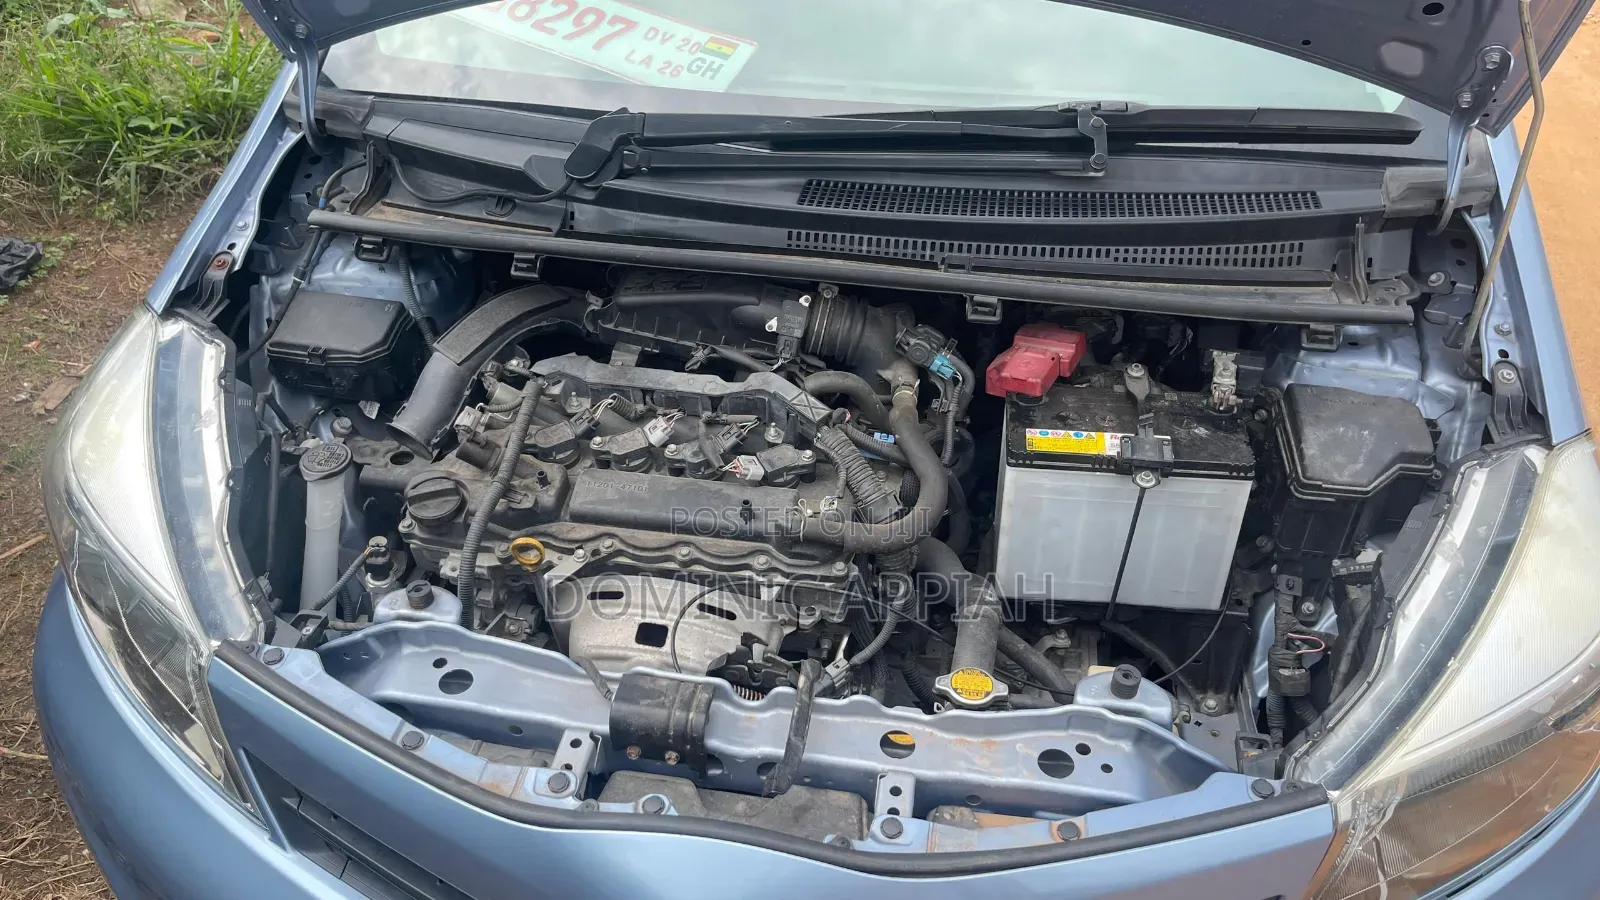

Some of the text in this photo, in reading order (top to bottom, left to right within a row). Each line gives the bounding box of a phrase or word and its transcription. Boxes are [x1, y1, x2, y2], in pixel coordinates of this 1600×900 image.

[643, 26, 702, 55] DV 20
[624, 49, 684, 78] LA 26
[686, 57, 724, 79] GH
